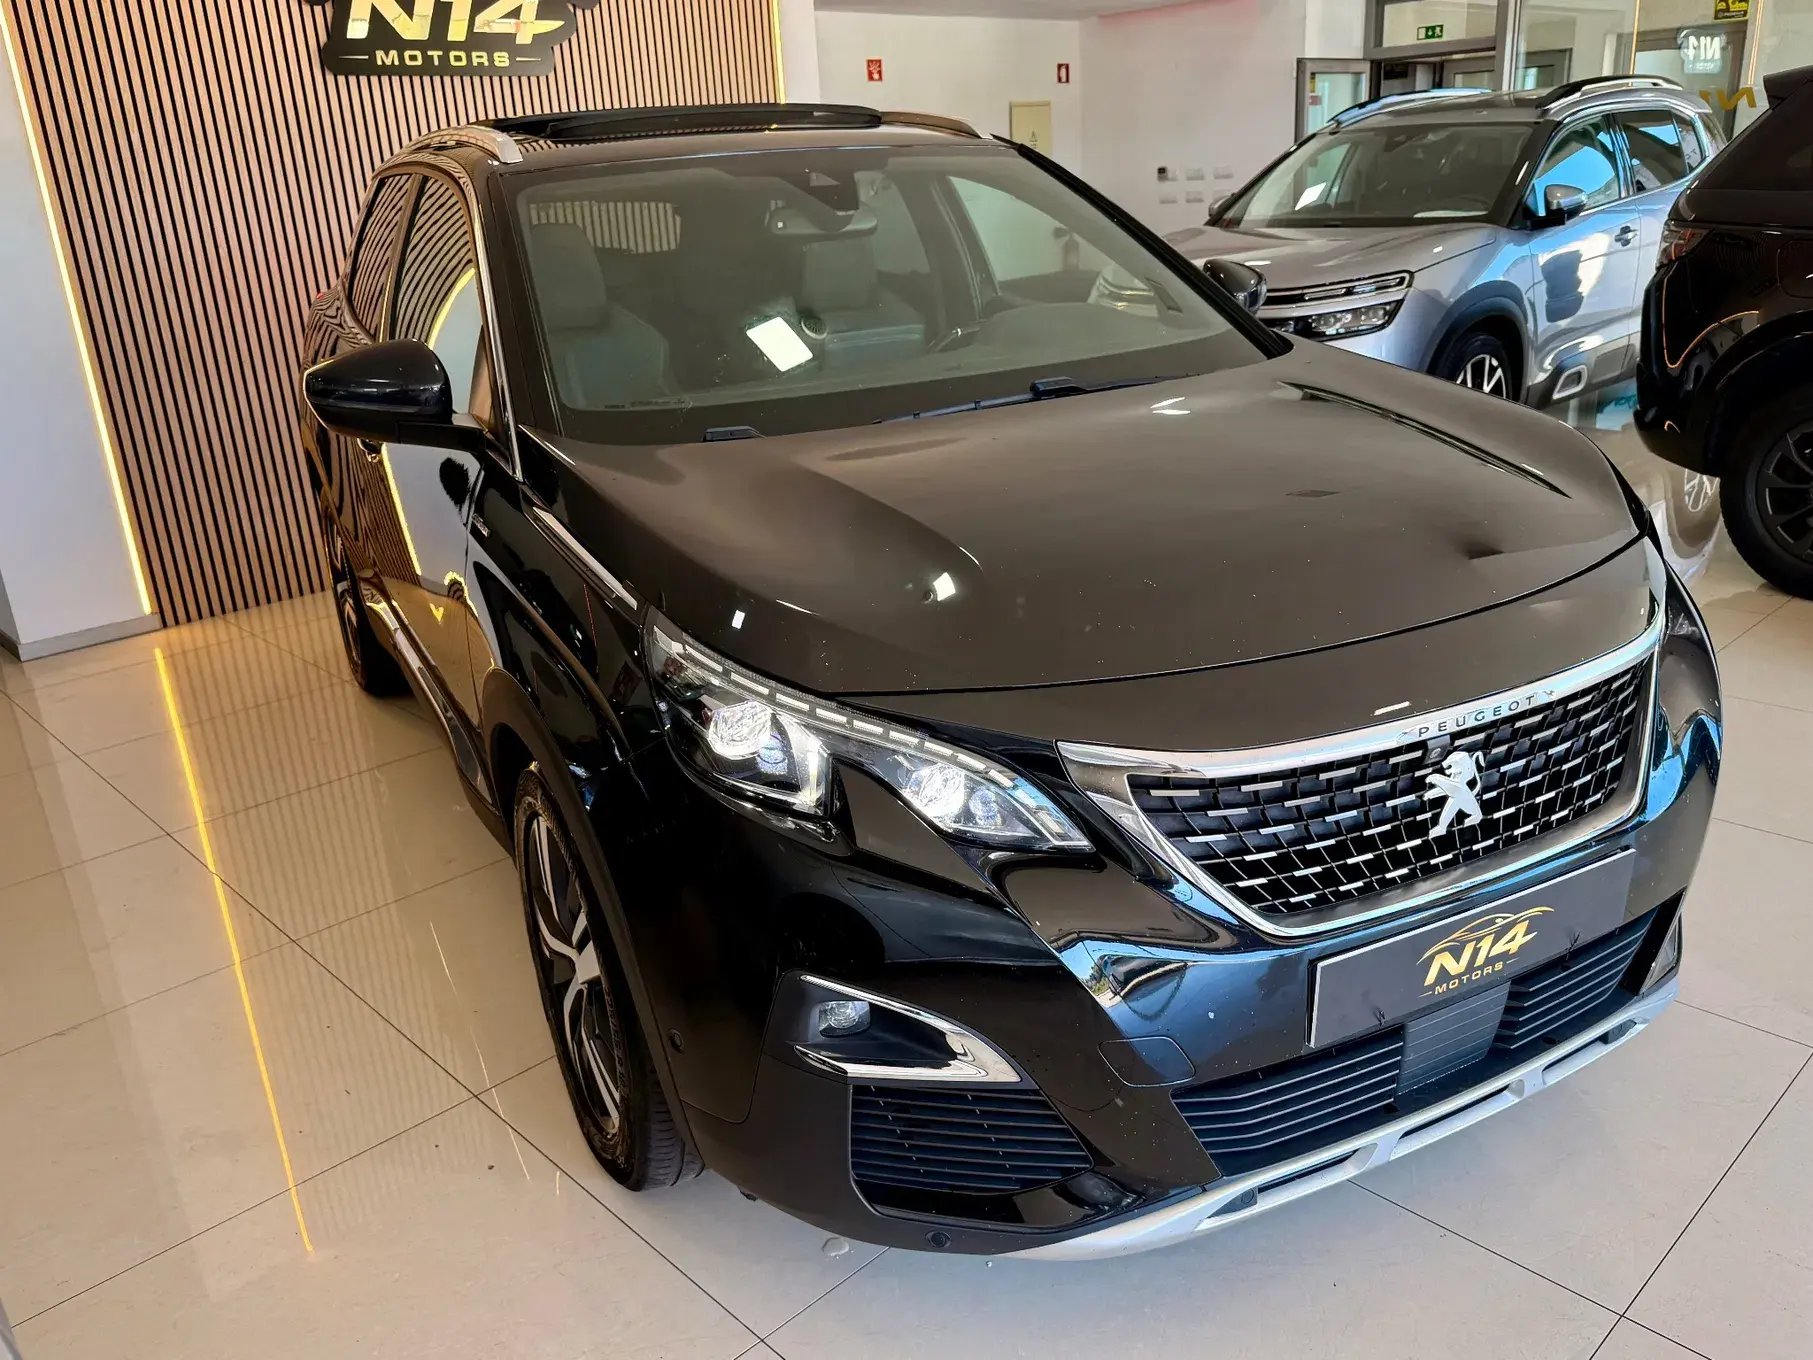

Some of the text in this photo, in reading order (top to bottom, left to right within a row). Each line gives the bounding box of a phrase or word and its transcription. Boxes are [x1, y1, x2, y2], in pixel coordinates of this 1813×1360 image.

[346, 0, 565, 45] N14
[375, 50, 510, 67] MOTORS
[1418, 694, 1535, 738] PEUGEOT
[1423, 919, 1538, 987] N14
[1434, 961, 1504, 995] MOTORS
